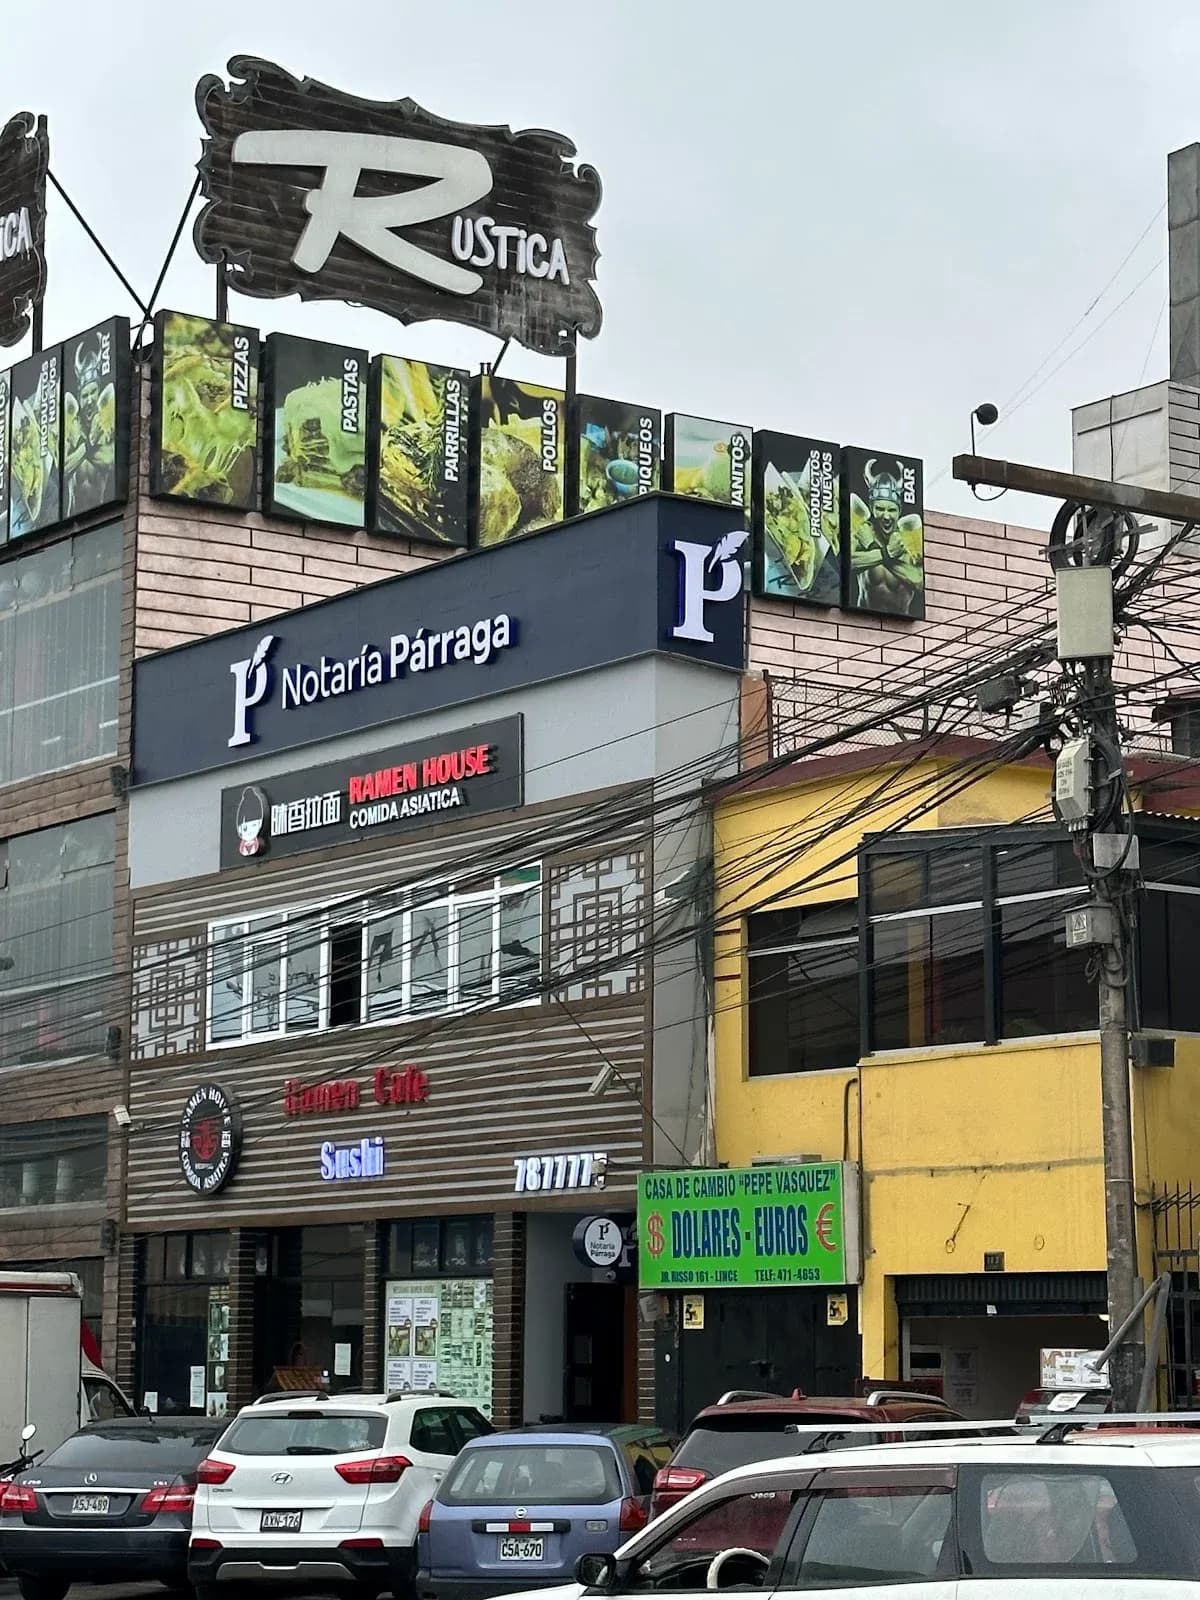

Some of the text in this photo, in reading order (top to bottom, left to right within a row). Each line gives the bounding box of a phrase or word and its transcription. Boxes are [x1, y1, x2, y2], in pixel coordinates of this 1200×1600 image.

[101, 331, 111, 376] BAR
[233, 336, 249, 410] PIZZAS
[40, 360, 49, 457] PRODUCTOS
[49, 356, 57, 423] NUEVOS
[343, 358, 359, 432] PASTAS
[444, 379, 461, 482] PARRILLAS
[542, 399, 557, 472] POLLOS
[638, 416, 653, 496] PIQUEOS
[810, 449, 821, 537] PRODUCTOS
[822, 452, 833, 512] NUEVOS
[903, 468, 915, 504] BAR
[282, 644, 382, 710] Notaría
[390, 613, 510, 679] Párraga
[350, 744, 490, 805] RAMEN HOUSE
[349, 787, 460, 830] COMIDA ASIATICA
[320, 1136, 385, 1180] Sushi
[645, 1177, 673, 1200] CASA
[676, 1177, 690, 1199] DE
[693, 1174, 736, 1198] CAMBIO
[671, 1207, 741, 1259] DOLARES
[754, 1204, 808, 1257] EUROS
[715, 1270, 738, 1283] LINCE
[754, 1269, 776, 1282] TELF:
[502, 1543, 542, 1557] C5A-670
